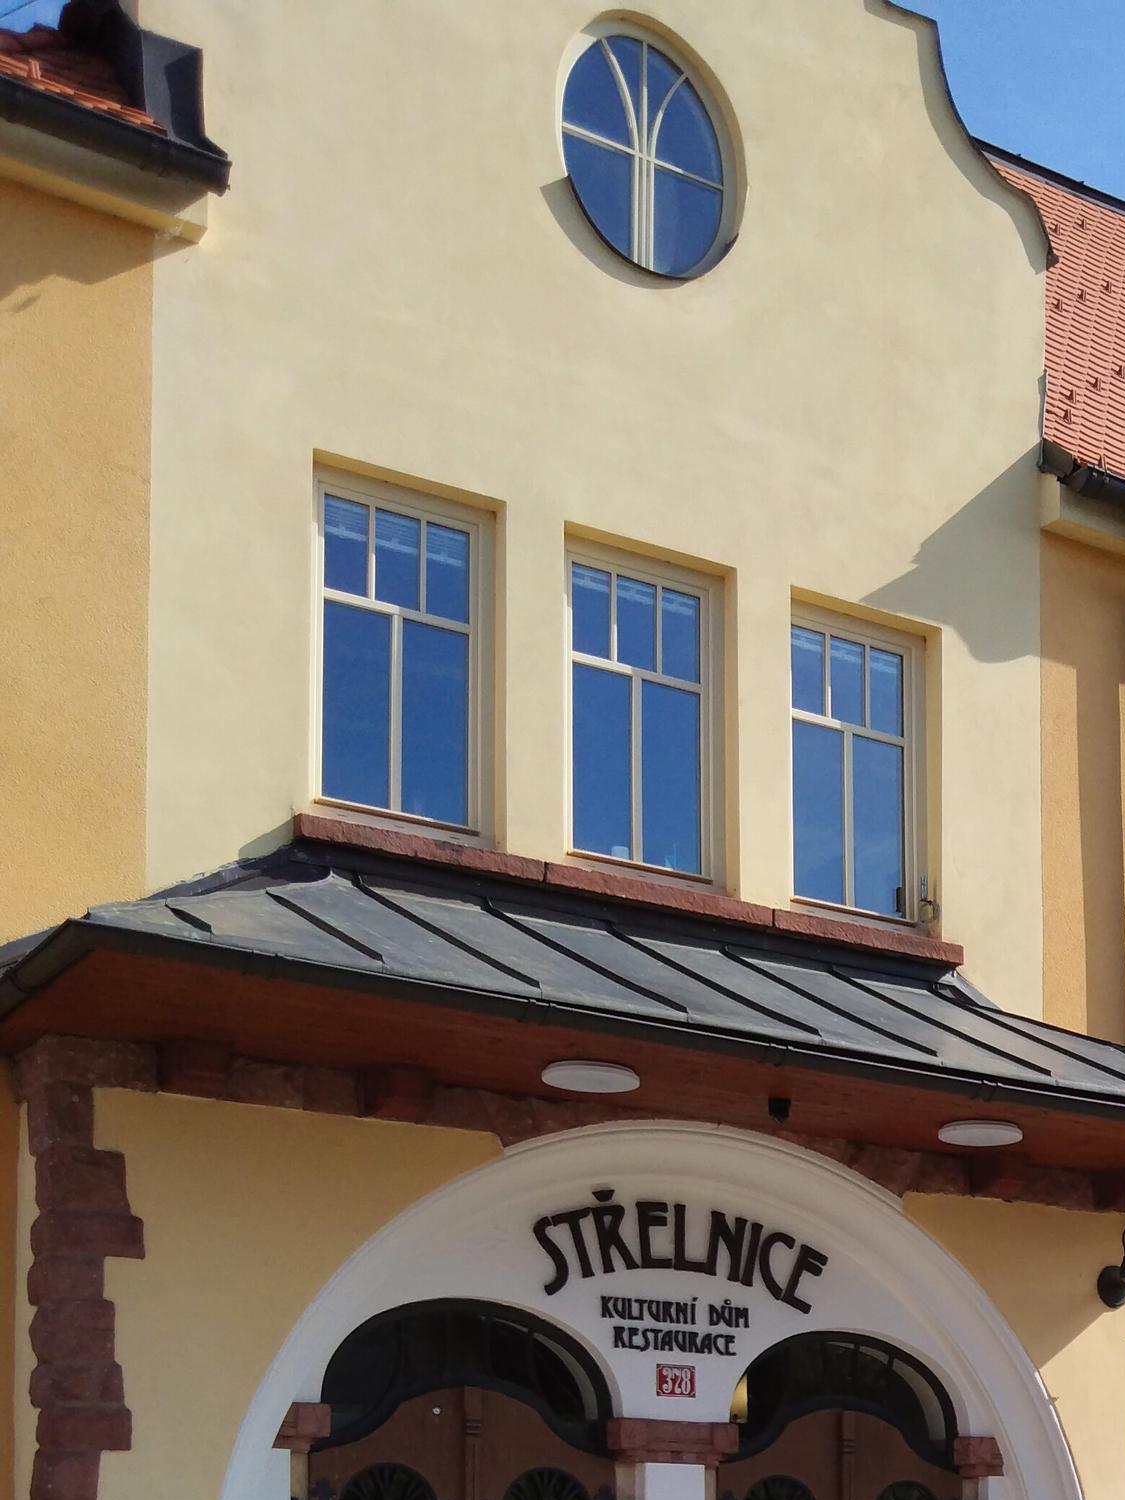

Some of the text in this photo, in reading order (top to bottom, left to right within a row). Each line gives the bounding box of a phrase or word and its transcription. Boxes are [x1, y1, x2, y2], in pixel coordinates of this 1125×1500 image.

[533, 1189, 829, 1314] STŘELNICE
[600, 1296, 750, 1328] KULTURNÍ DŮM
[613, 1326, 736, 1356] RESTAURACE
[662, 1367, 691, 1395] 378
